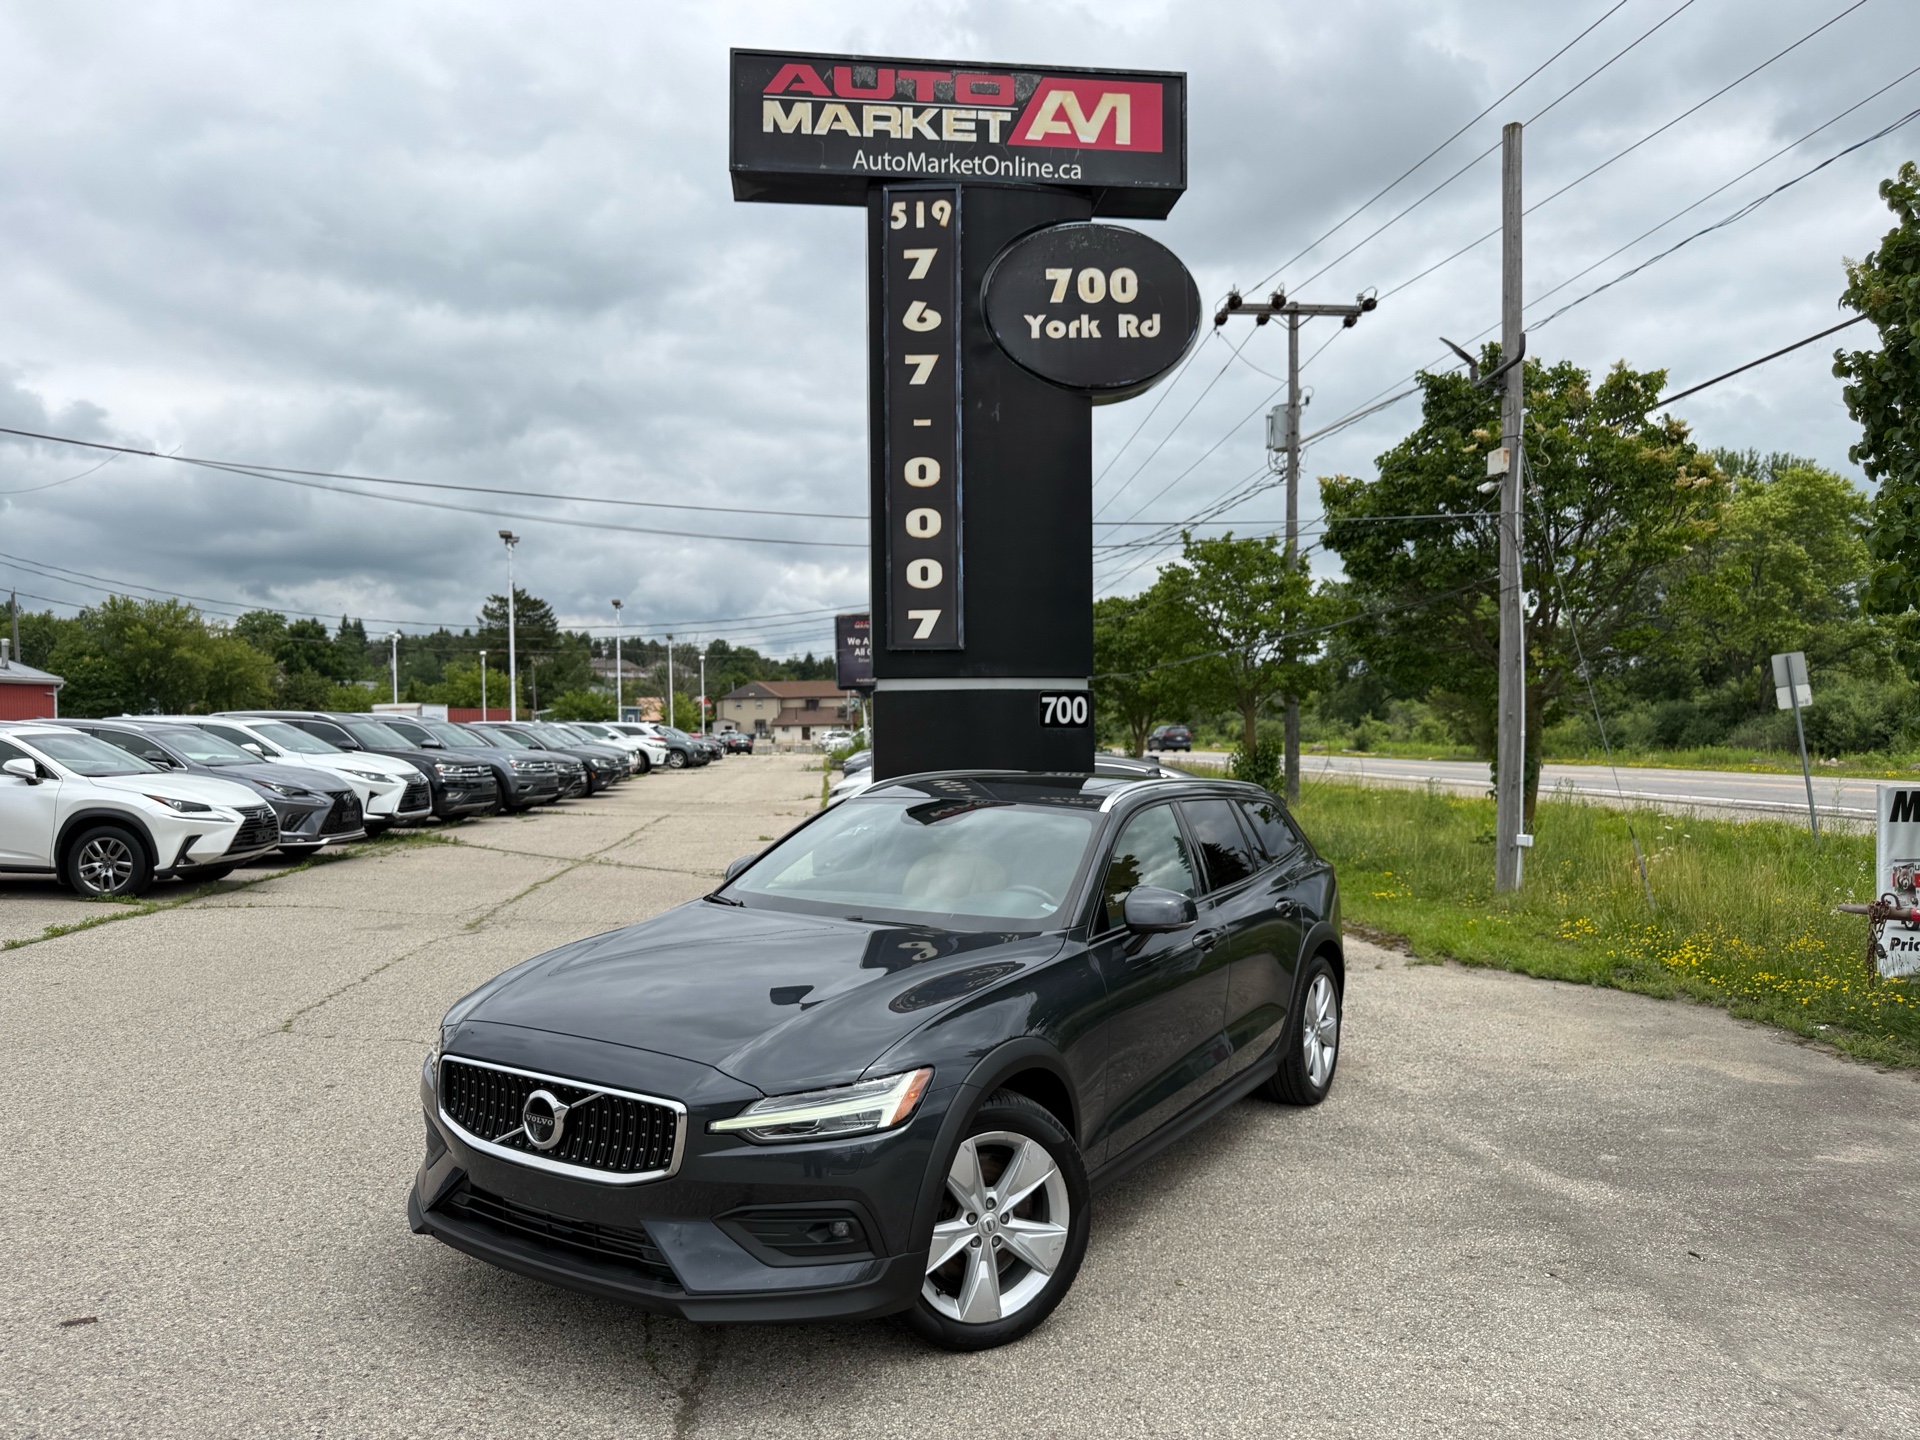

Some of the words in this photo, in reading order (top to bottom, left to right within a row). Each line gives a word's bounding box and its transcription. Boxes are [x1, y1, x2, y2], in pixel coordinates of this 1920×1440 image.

[763, 63, 1015, 106] AUTO
[763, 100, 1012, 142] MARKET
[1025, 90, 1131, 145] AM
[852, 149, 1083, 180] AutoMarketOnline.ca
[890, 199, 952, 230] 519
[1045, 267, 1139, 304] 700
[1023, 313, 1102, 339] York
[1118, 313, 1161, 338] Rd
[847, 637, 861, 646] We
[854, 647, 865, 656] All
[1041, 696, 1088, 725] 700
[526, 1114, 553, 1126] VOLVO
